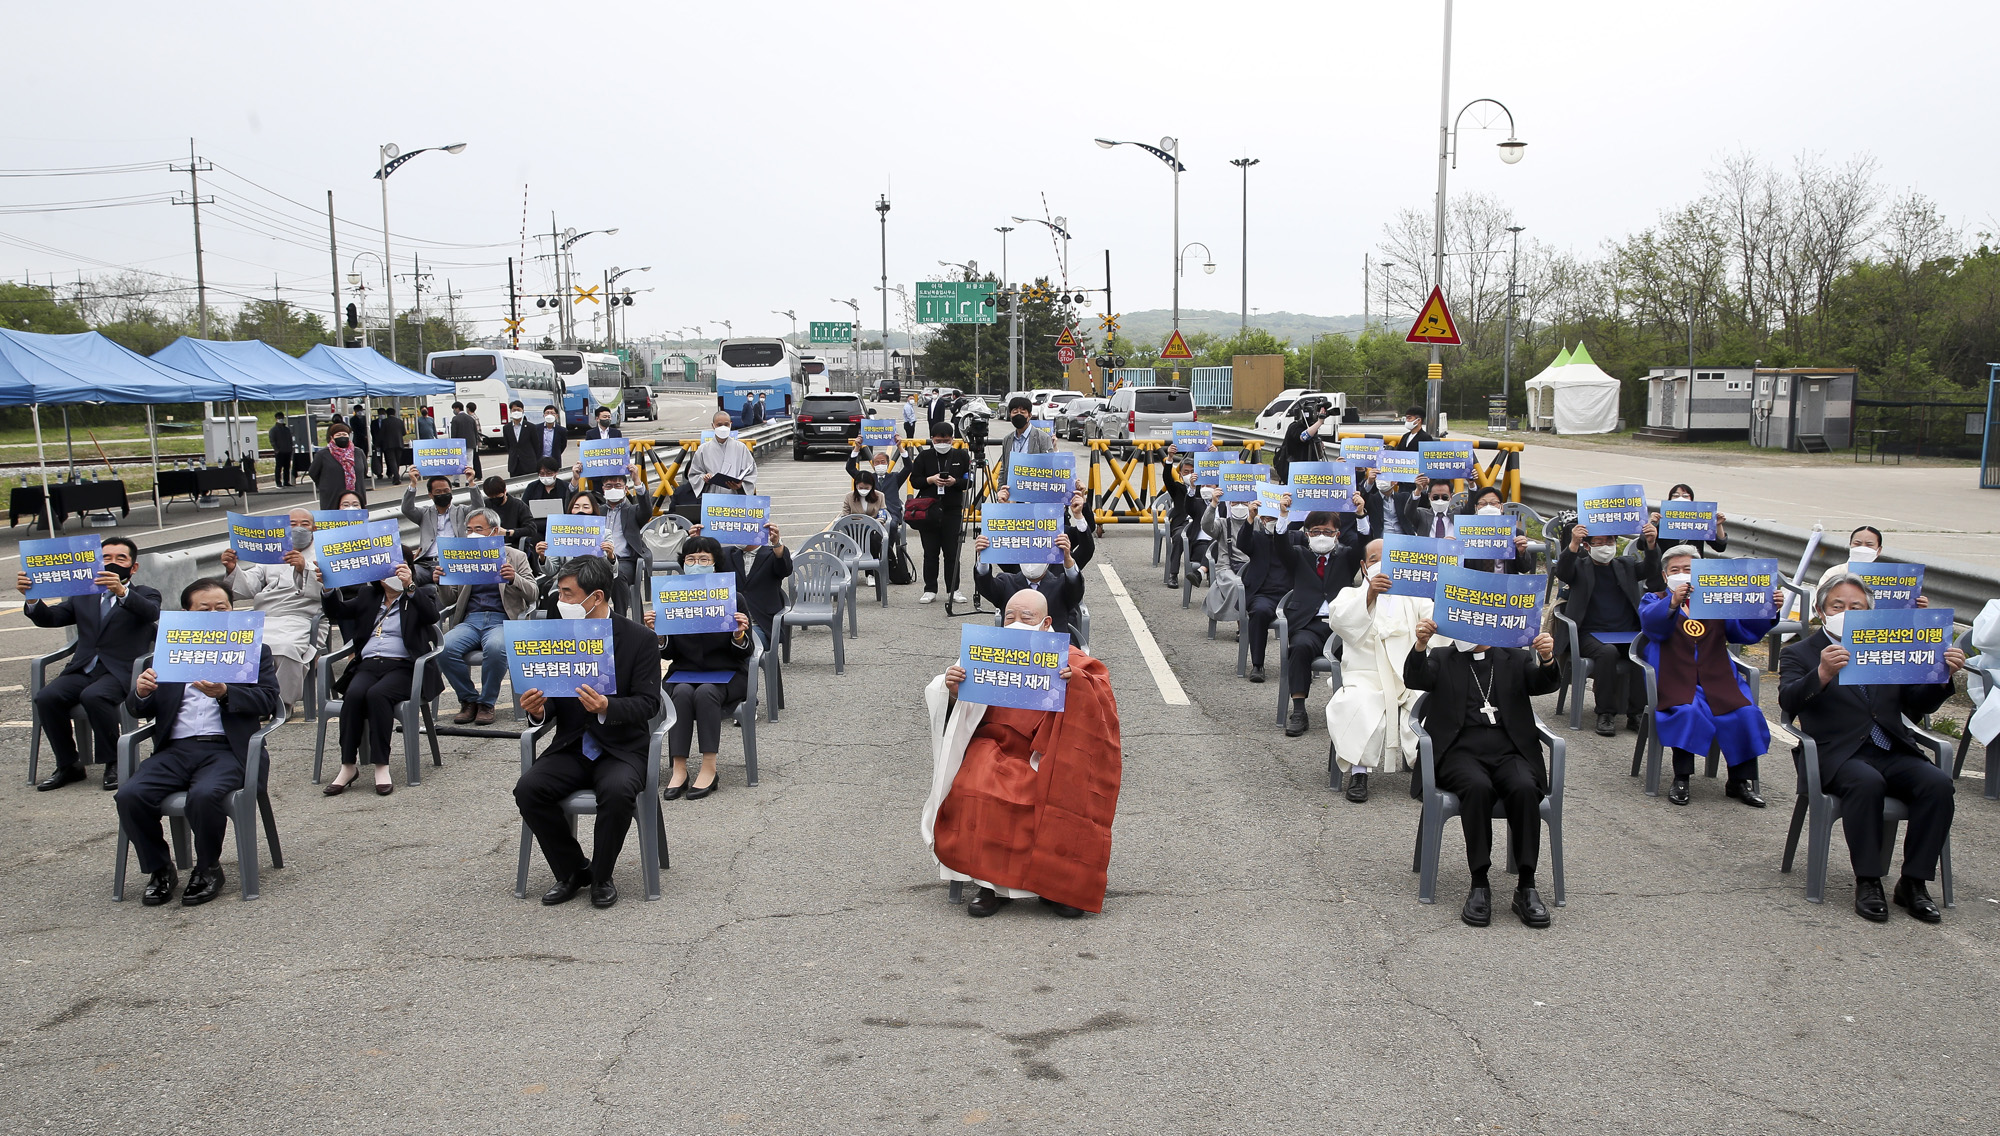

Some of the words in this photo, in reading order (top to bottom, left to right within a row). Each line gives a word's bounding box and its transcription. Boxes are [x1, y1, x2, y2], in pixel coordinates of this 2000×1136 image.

[418, 448, 448, 456] 판문점선언
[584, 449, 612, 457] 판문점선언
[613, 447, 625, 456] 이행
[421, 458, 446, 466] 남북협력
[447, 458, 460, 466] 재개
[586, 459, 610, 467] 남북협력
[611, 458, 623, 466] 재개
[1014, 466, 1053, 478] 판문점선언
[1054, 469, 1070, 479] 이행
[1294, 474, 1334, 485] 판문점선언
[1336, 475, 1351, 485] 이행
[1016, 480, 1048, 491] 남북협력
[1050, 482, 1065, 492] 재개
[1296, 489, 1329, 499] 남북협력
[1330, 489, 1347, 499] 재개
[1584, 498, 1626, 509] 판문점선언
[1627, 498, 1642, 507] 이행
[707, 506, 746, 517] 판문점선언
[748, 508, 764, 518] 이행
[1588, 513, 1622, 523] 남북협력
[1623, 512, 1640, 522] 재개
[1665, 510, 1698, 519] 판문점선언
[1698, 511, 1712, 520] 이행
[551, 525, 584, 534] 판문점선언
[585, 526, 599, 535] 이행
[710, 520, 741, 531] 남북협력
[742, 522, 759, 533] 재개
[988, 519, 1035, 531] 판문점선언
[1037, 519, 1057, 531] 이행
[1460, 526, 1496, 535] 판문점선언
[1497, 526, 1511, 535] 이행
[1668, 522, 1693, 530] 남북협력
[233, 525, 266, 538] 판문점선언
[268, 528, 285, 538] 이행
[237, 539, 263, 552] 남북협력
[264, 542, 282, 552] 재개
[322, 538, 371, 556] 판문점선언
[373, 535, 393, 548] 이행
[553, 537, 579, 546] 남북협력
[581, 538, 596, 546] 재개
[992, 537, 1030, 549] 남북협력
[1032, 537, 1052, 548] 재개
[1463, 539, 1491, 548] 남북협력
[1492, 539, 1508, 548] 재개
[26, 552, 73, 567] 판문점선언
[74, 550, 95, 562] 이행
[443, 550, 481, 559] 판문점선언
[482, 548, 499, 558] 이행
[1389, 550, 1437, 566] 판문점선언
[1439, 556, 1458, 567] 이행
[330, 557, 369, 573] 남북협력
[371, 552, 391, 565] 재개
[448, 563, 479, 573] 남북협력
[481, 563, 497, 572] 재개
[32, 570, 71, 584] 남북협력
[72, 568, 92, 580] 재개
[1393, 568, 1431, 582] 남북협력
[1698, 574, 1748, 587] 판문점선언
[1750, 574, 1770, 587] 이행
[1860, 575, 1897, 586] 문점선언
[1899, 576, 1916, 586] 이행
[660, 589, 708, 603] 판문점선언
[709, 588, 729, 600] 이행
[1445, 584, 1508, 608] 판문점선언
[1510, 593, 1535, 609] 이행
[1703, 592, 1744, 604] 남북협력
[1745, 592, 1765, 604] 재개
[1872, 590, 1891, 600] 협력
[1893, 590, 1910, 600] 재개
[665, 607, 703, 619] 남북협력
[705, 606, 724, 618] 재개
[1448, 608, 1498, 628] 남북협력
[1500, 614, 1527, 630] 재개
[166, 630, 227, 644] 판문점선언
[230, 630, 254, 644] 이행
[1852, 629, 1914, 644] 판문점선언
[1916, 629, 1942, 643] 이행
[514, 640, 576, 655] 판문점선언
[579, 639, 603, 654] 이행
[169, 650, 218, 664] 남북협력
[220, 650, 246, 665] 재개
[969, 645, 1030, 666] 판문점선언
[1033, 652, 1059, 669] 이행
[1856, 650, 1907, 665] 남북협력
[1909, 650, 1934, 665] 재개
[522, 662, 571, 677] 남북협력
[573, 662, 598, 677] 재개
[974, 669, 1022, 688] 남북협력
[1024, 674, 1050, 690] 재개
